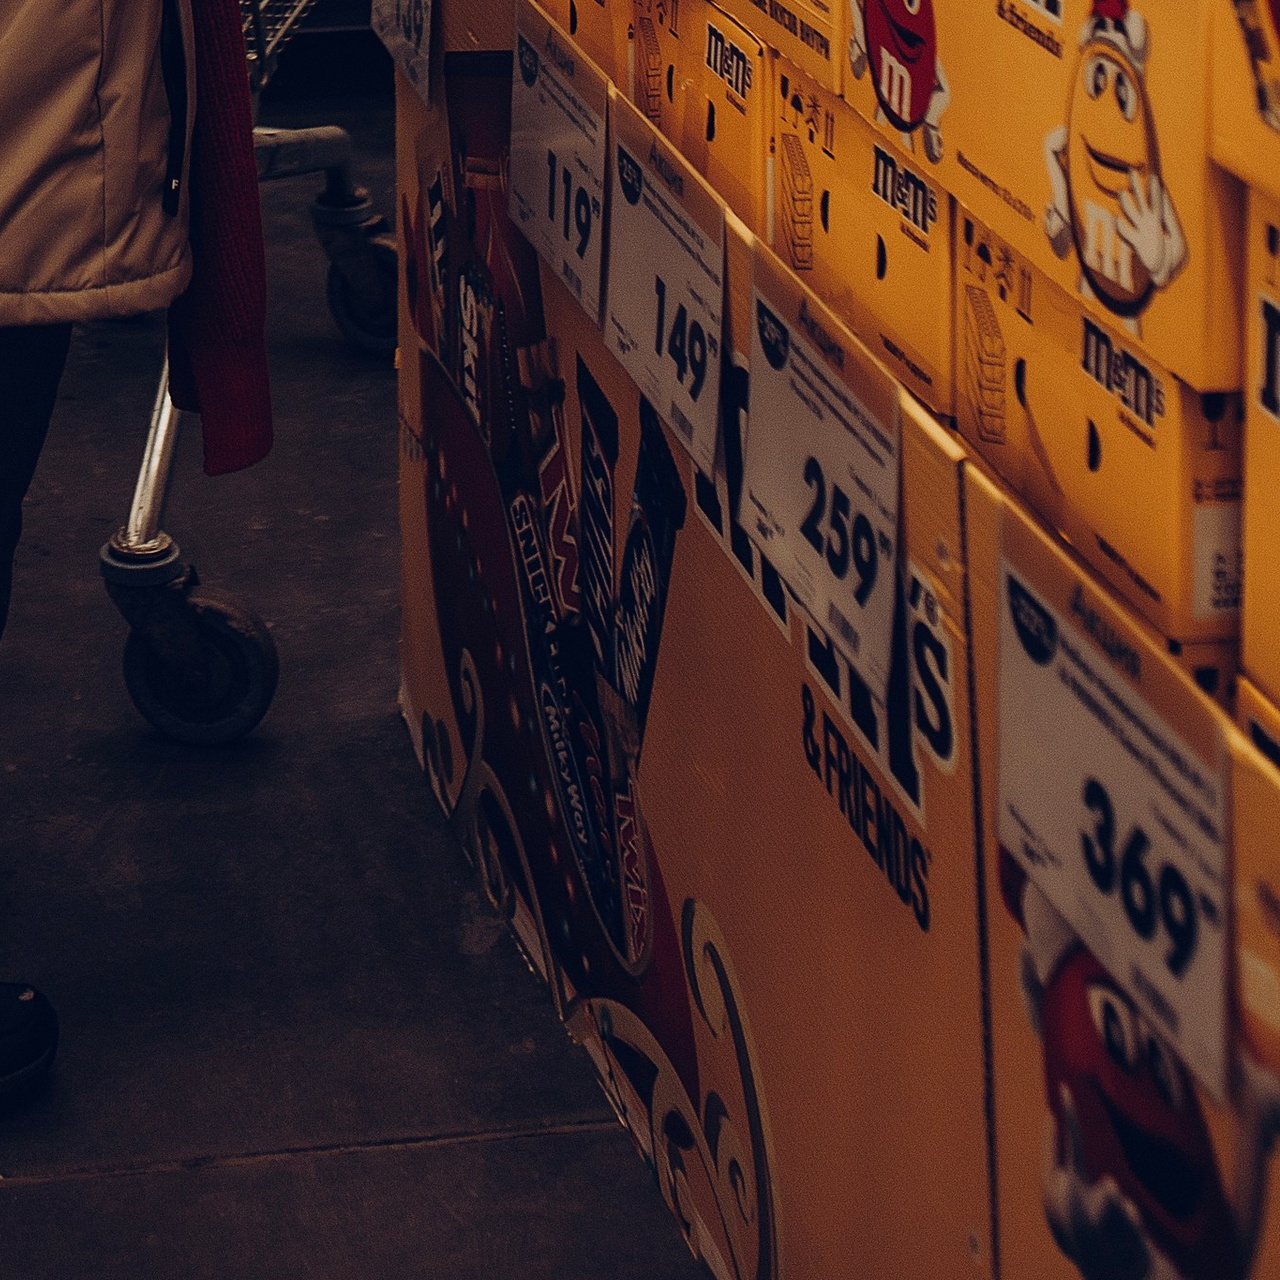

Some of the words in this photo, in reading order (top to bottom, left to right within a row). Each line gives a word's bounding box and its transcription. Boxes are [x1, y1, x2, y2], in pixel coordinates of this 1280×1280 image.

[706, 21, 753, 100] m&m's
[548, 149, 592, 260] 119
[872, 144, 938, 236] m&m's
[654, 274, 707, 402] 149
[800, 456, 876, 609] 259
[823, 708, 934, 932] FRIENDS
[1082, 777, 1197, 978] 369
